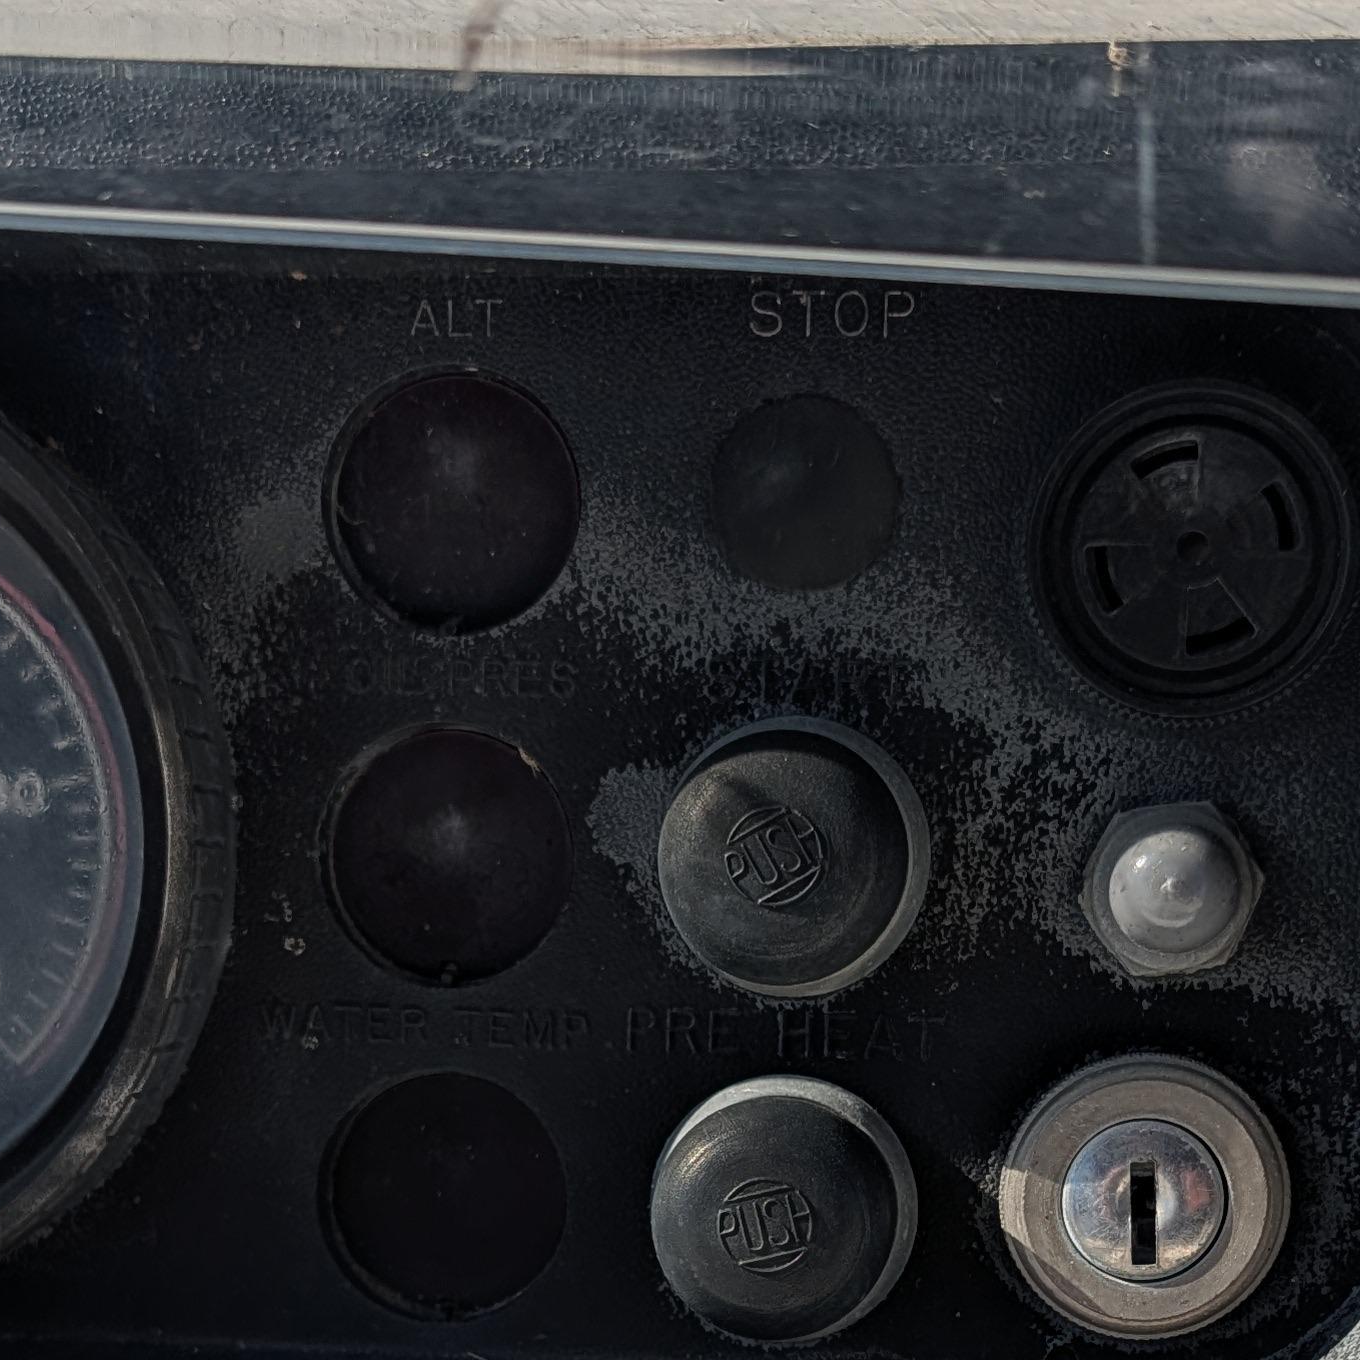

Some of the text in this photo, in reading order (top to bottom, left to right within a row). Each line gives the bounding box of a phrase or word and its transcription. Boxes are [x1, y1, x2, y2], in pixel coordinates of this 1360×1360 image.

[409, 299, 503, 338] ALT
[749, 290, 916, 339] STOP
[723, 809, 824, 886] PUSH
[260, 1000, 589, 1052] WATER TEMP
[625, 1007, 947, 1062] PRE HEAT
[716, 1191, 814, 1252] PUSH
